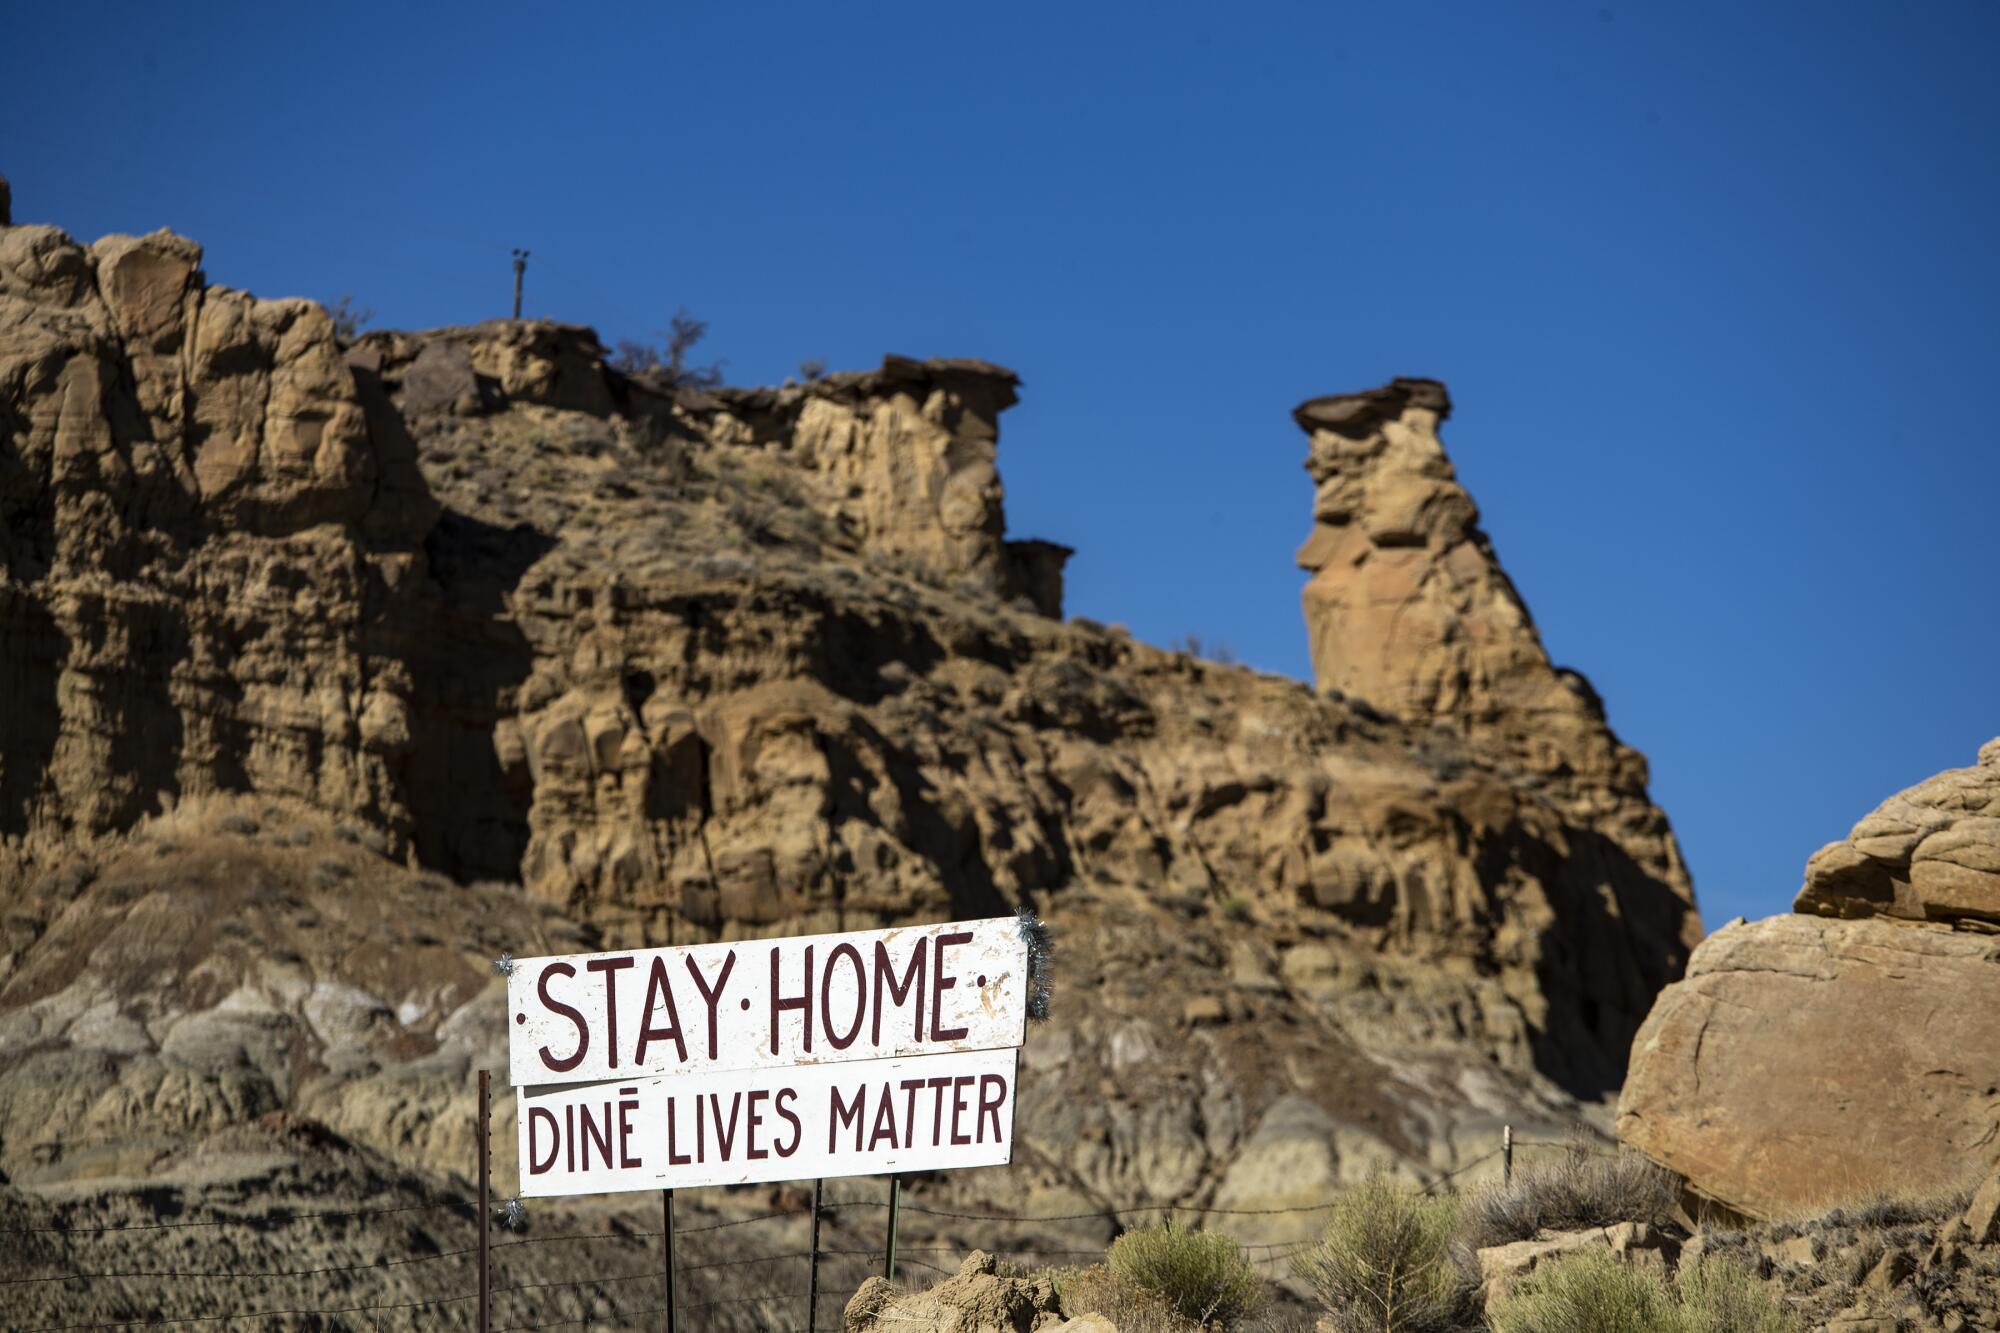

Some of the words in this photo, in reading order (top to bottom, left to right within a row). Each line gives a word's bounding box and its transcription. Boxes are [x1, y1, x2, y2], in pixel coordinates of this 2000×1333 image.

[537, 949, 736, 1073] STAY
[770, 932, 974, 1056] HOME
[667, 1088, 802, 1166] LIVES
[828, 1074, 1007, 1154] MATTER
